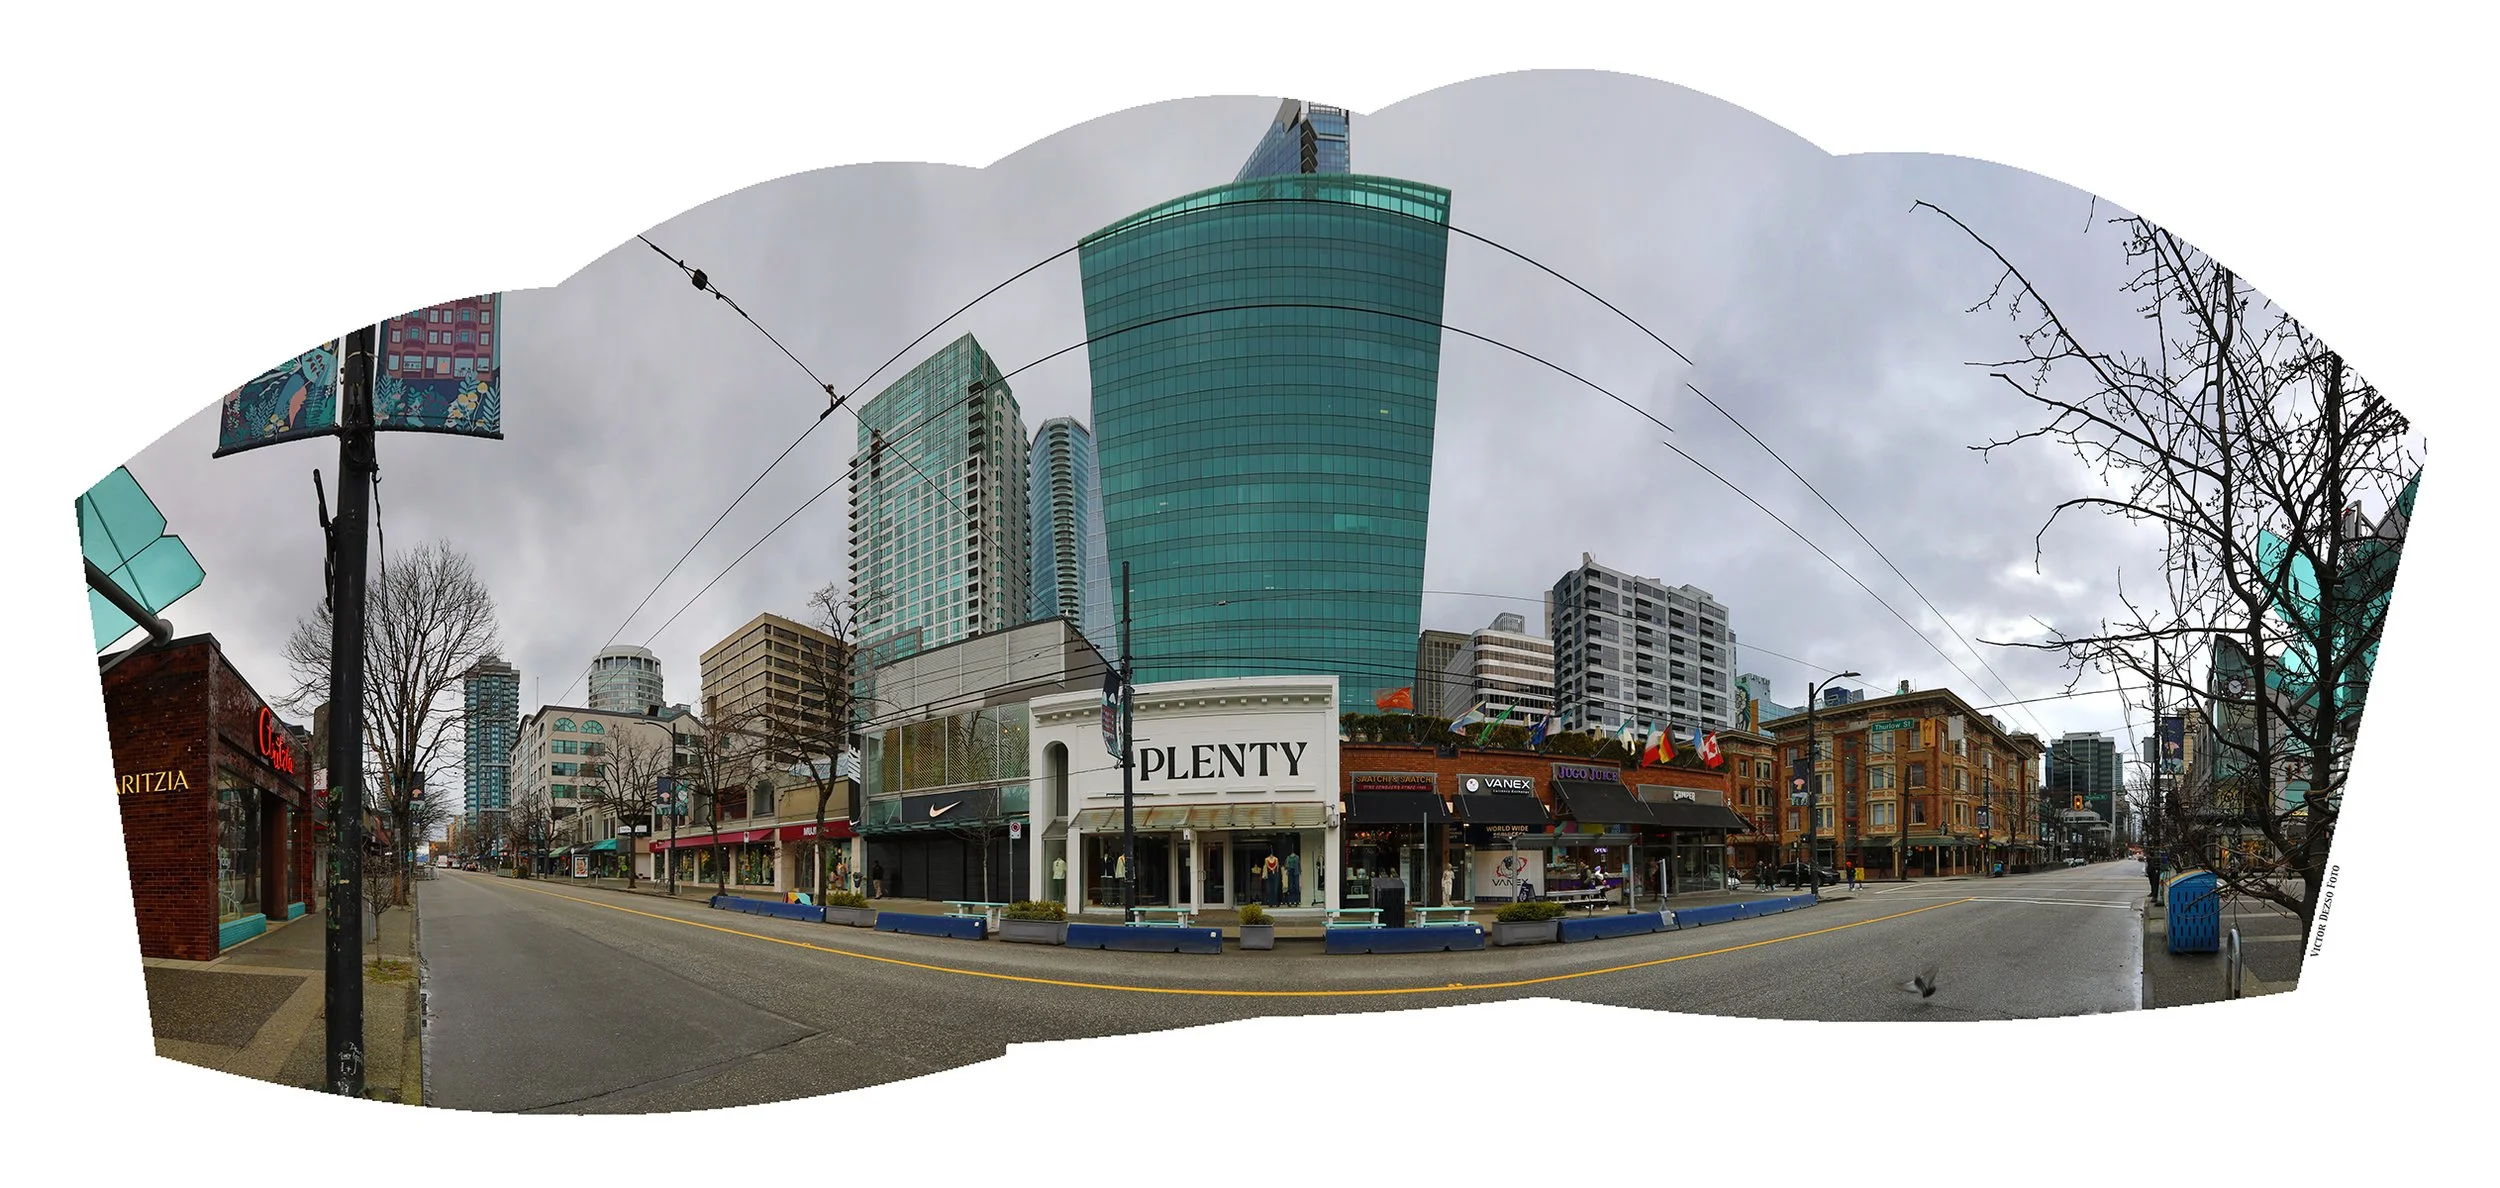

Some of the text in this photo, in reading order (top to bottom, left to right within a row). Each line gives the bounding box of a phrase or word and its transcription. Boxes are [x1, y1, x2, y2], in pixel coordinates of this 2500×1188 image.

[1874, 720, 1911, 730] Thurlow St
[1139, 741, 1308, 782] PLENTY
[1355, 775, 1391, 783] SAATCHI
[1392, 775, 1398, 783] &
[1559, 766, 1618, 781] JUGO JUICE
[116, 770, 189, 795] RITZIA
[1484, 778, 1531, 790] VANEX
